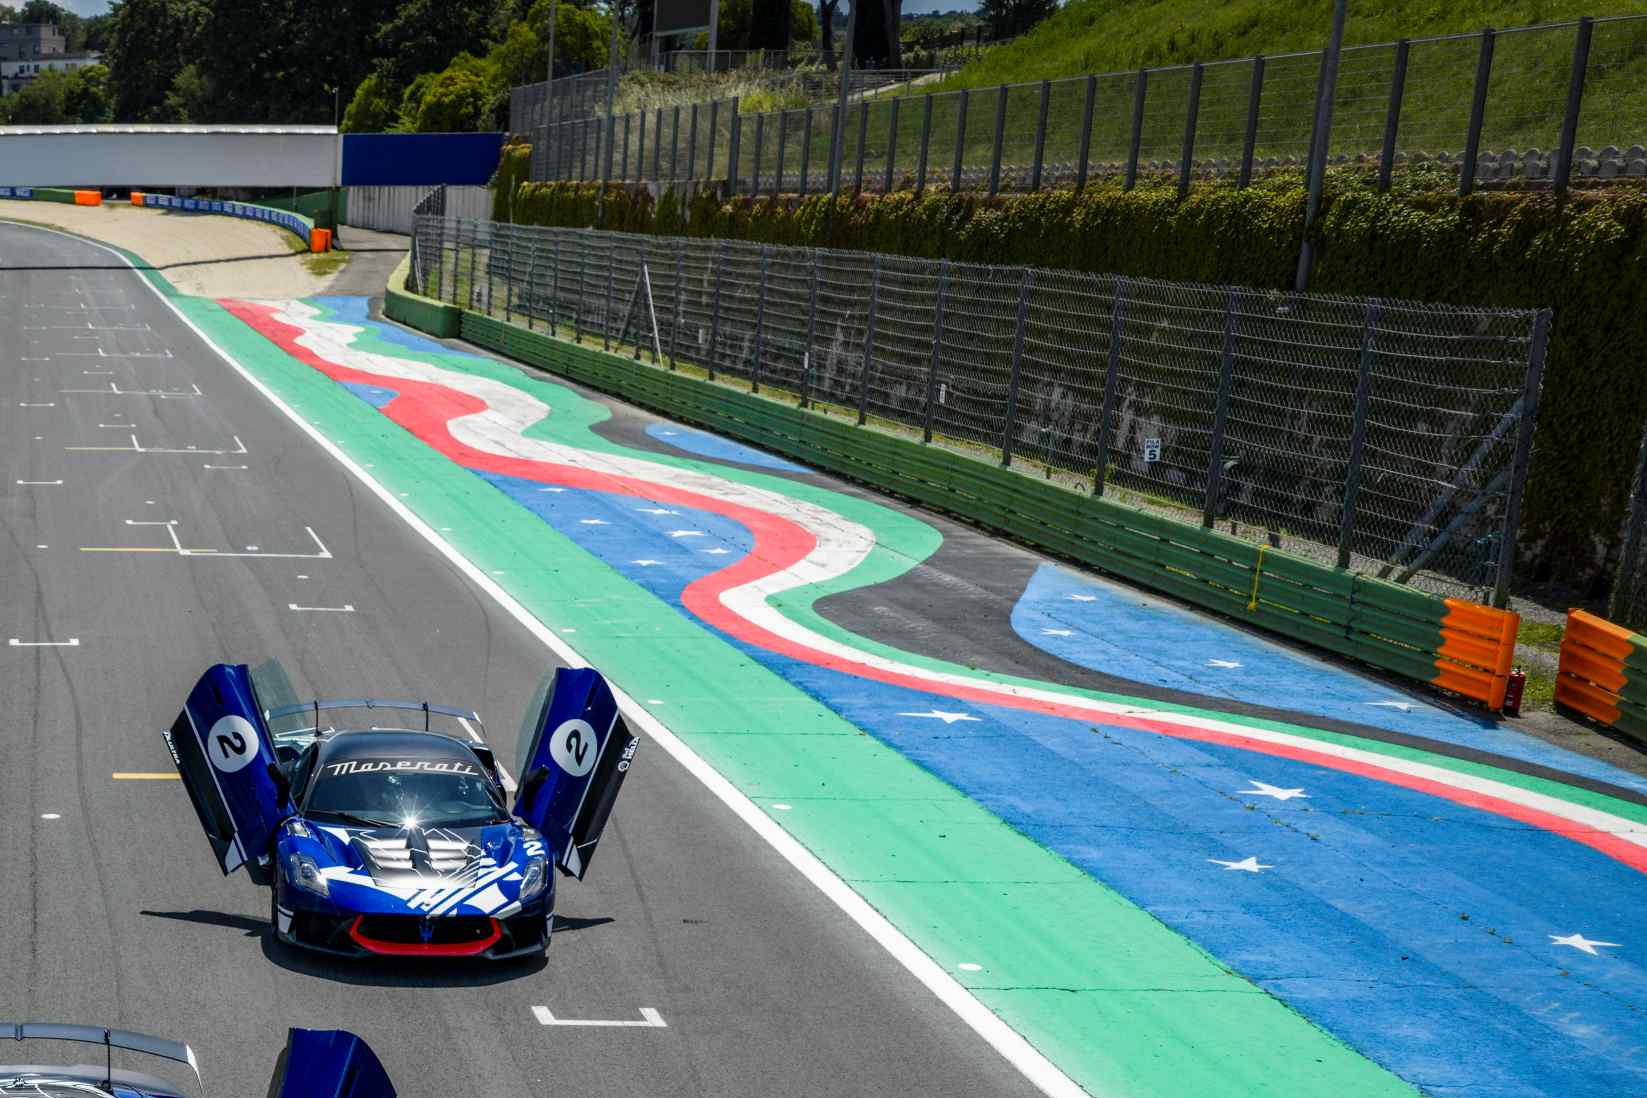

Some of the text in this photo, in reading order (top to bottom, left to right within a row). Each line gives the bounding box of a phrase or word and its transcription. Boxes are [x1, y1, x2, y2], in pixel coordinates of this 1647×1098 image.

[1148, 450, 1157, 460] 5
[216, 731, 247, 759] 2
[566, 729, 588, 768] 2
[327, 760, 479, 776] Maserati
[523, 841, 545, 856] 2
